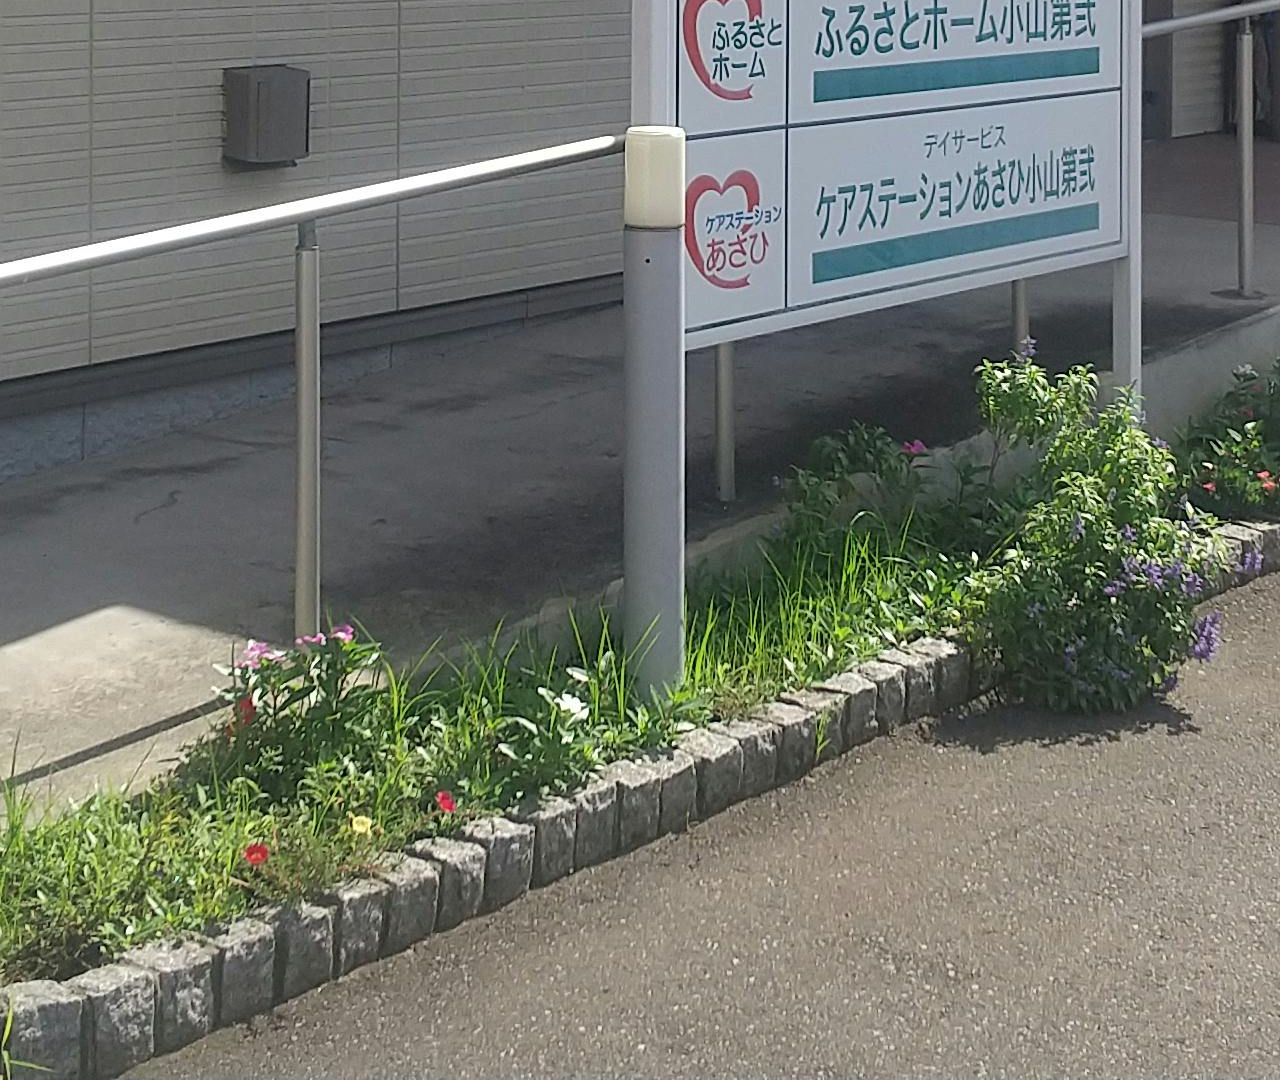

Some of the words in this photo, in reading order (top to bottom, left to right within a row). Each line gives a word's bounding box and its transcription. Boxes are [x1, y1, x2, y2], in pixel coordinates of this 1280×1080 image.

[712, 18, 782, 50] ふるさと
[712, 51, 765, 81] ホーム
[924, 125, 1006, 158] デイサービス
[816, 143, 1095, 240] ケアステーションあさひ小山第弐
[705, 206, 781, 234] ケアステーション
[705, 231, 769, 272] あさひ
